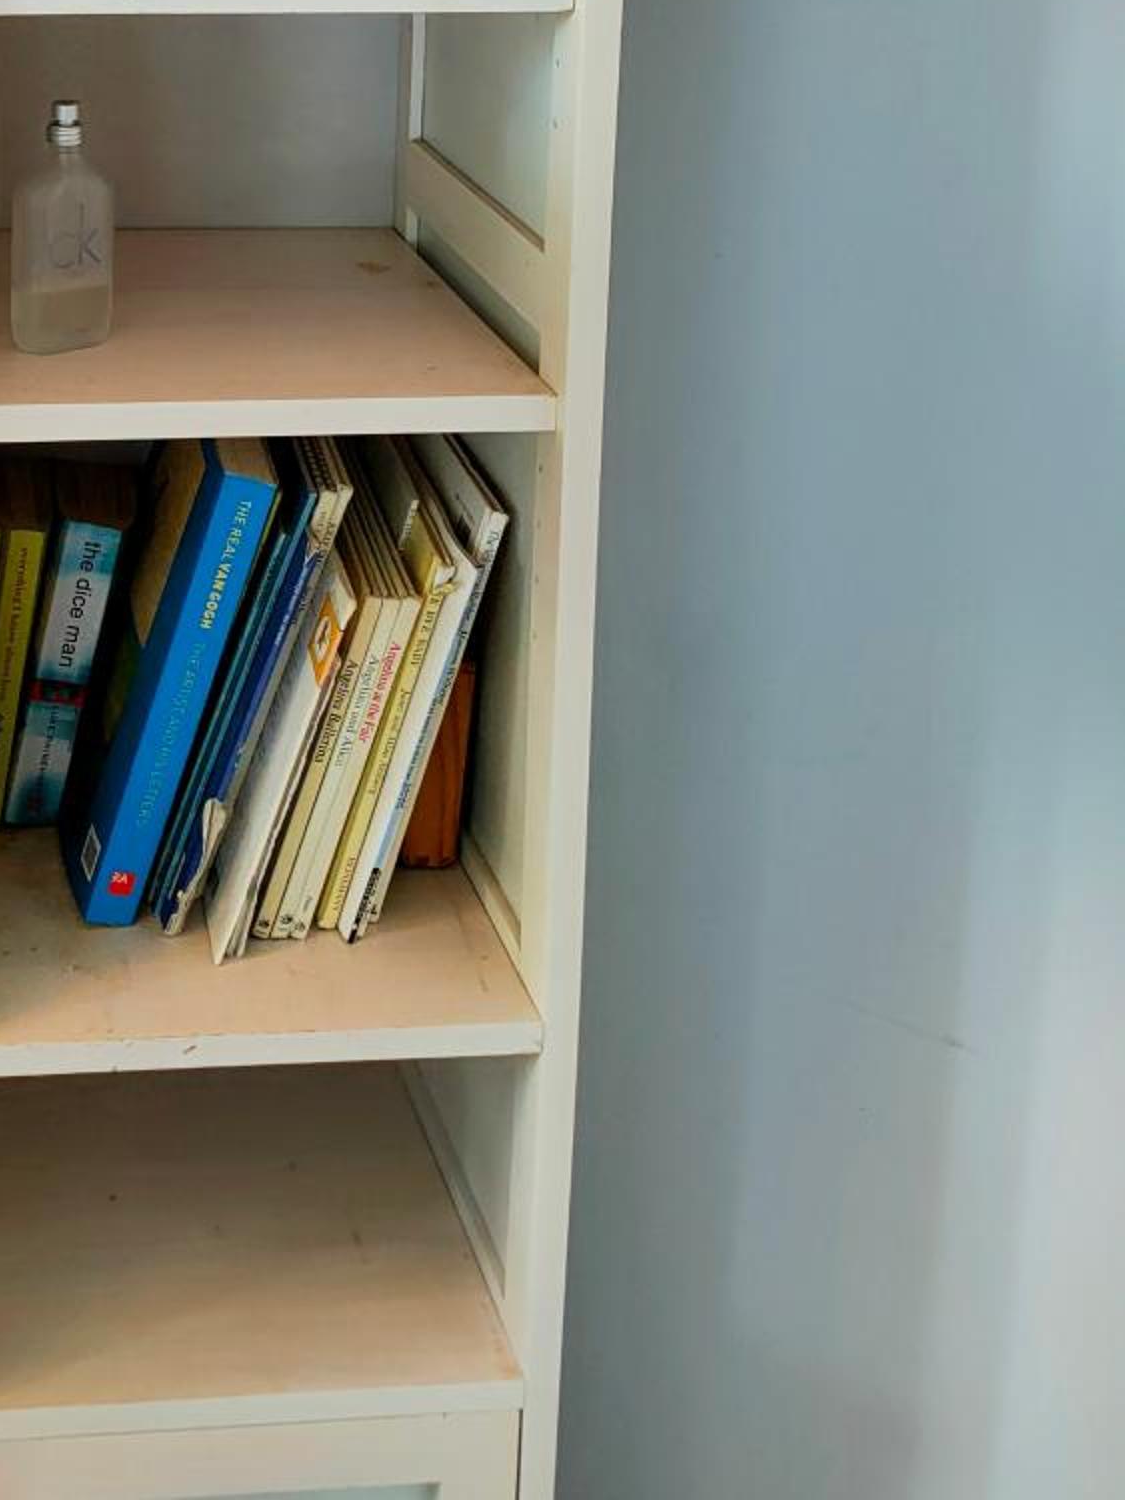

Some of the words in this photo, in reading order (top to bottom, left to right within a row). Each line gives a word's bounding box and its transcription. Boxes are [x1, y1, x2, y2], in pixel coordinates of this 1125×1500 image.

[235, 501, 252, 526] THE
[80, 541, 102, 573] the
[221, 528, 242, 559] REAL
[212, 563, 232, 591] VAN
[69, 577, 92, 619] dice
[200, 591, 222, 629] GOGH
[59, 624, 81, 668] man
[377, 641, 402, 690] Angelina
[333, 660, 359, 709] Angelina
[356, 654, 379, 708] Angelina
[315, 713, 342, 763] Ballerina
[358, 721, 375, 744] Fair
